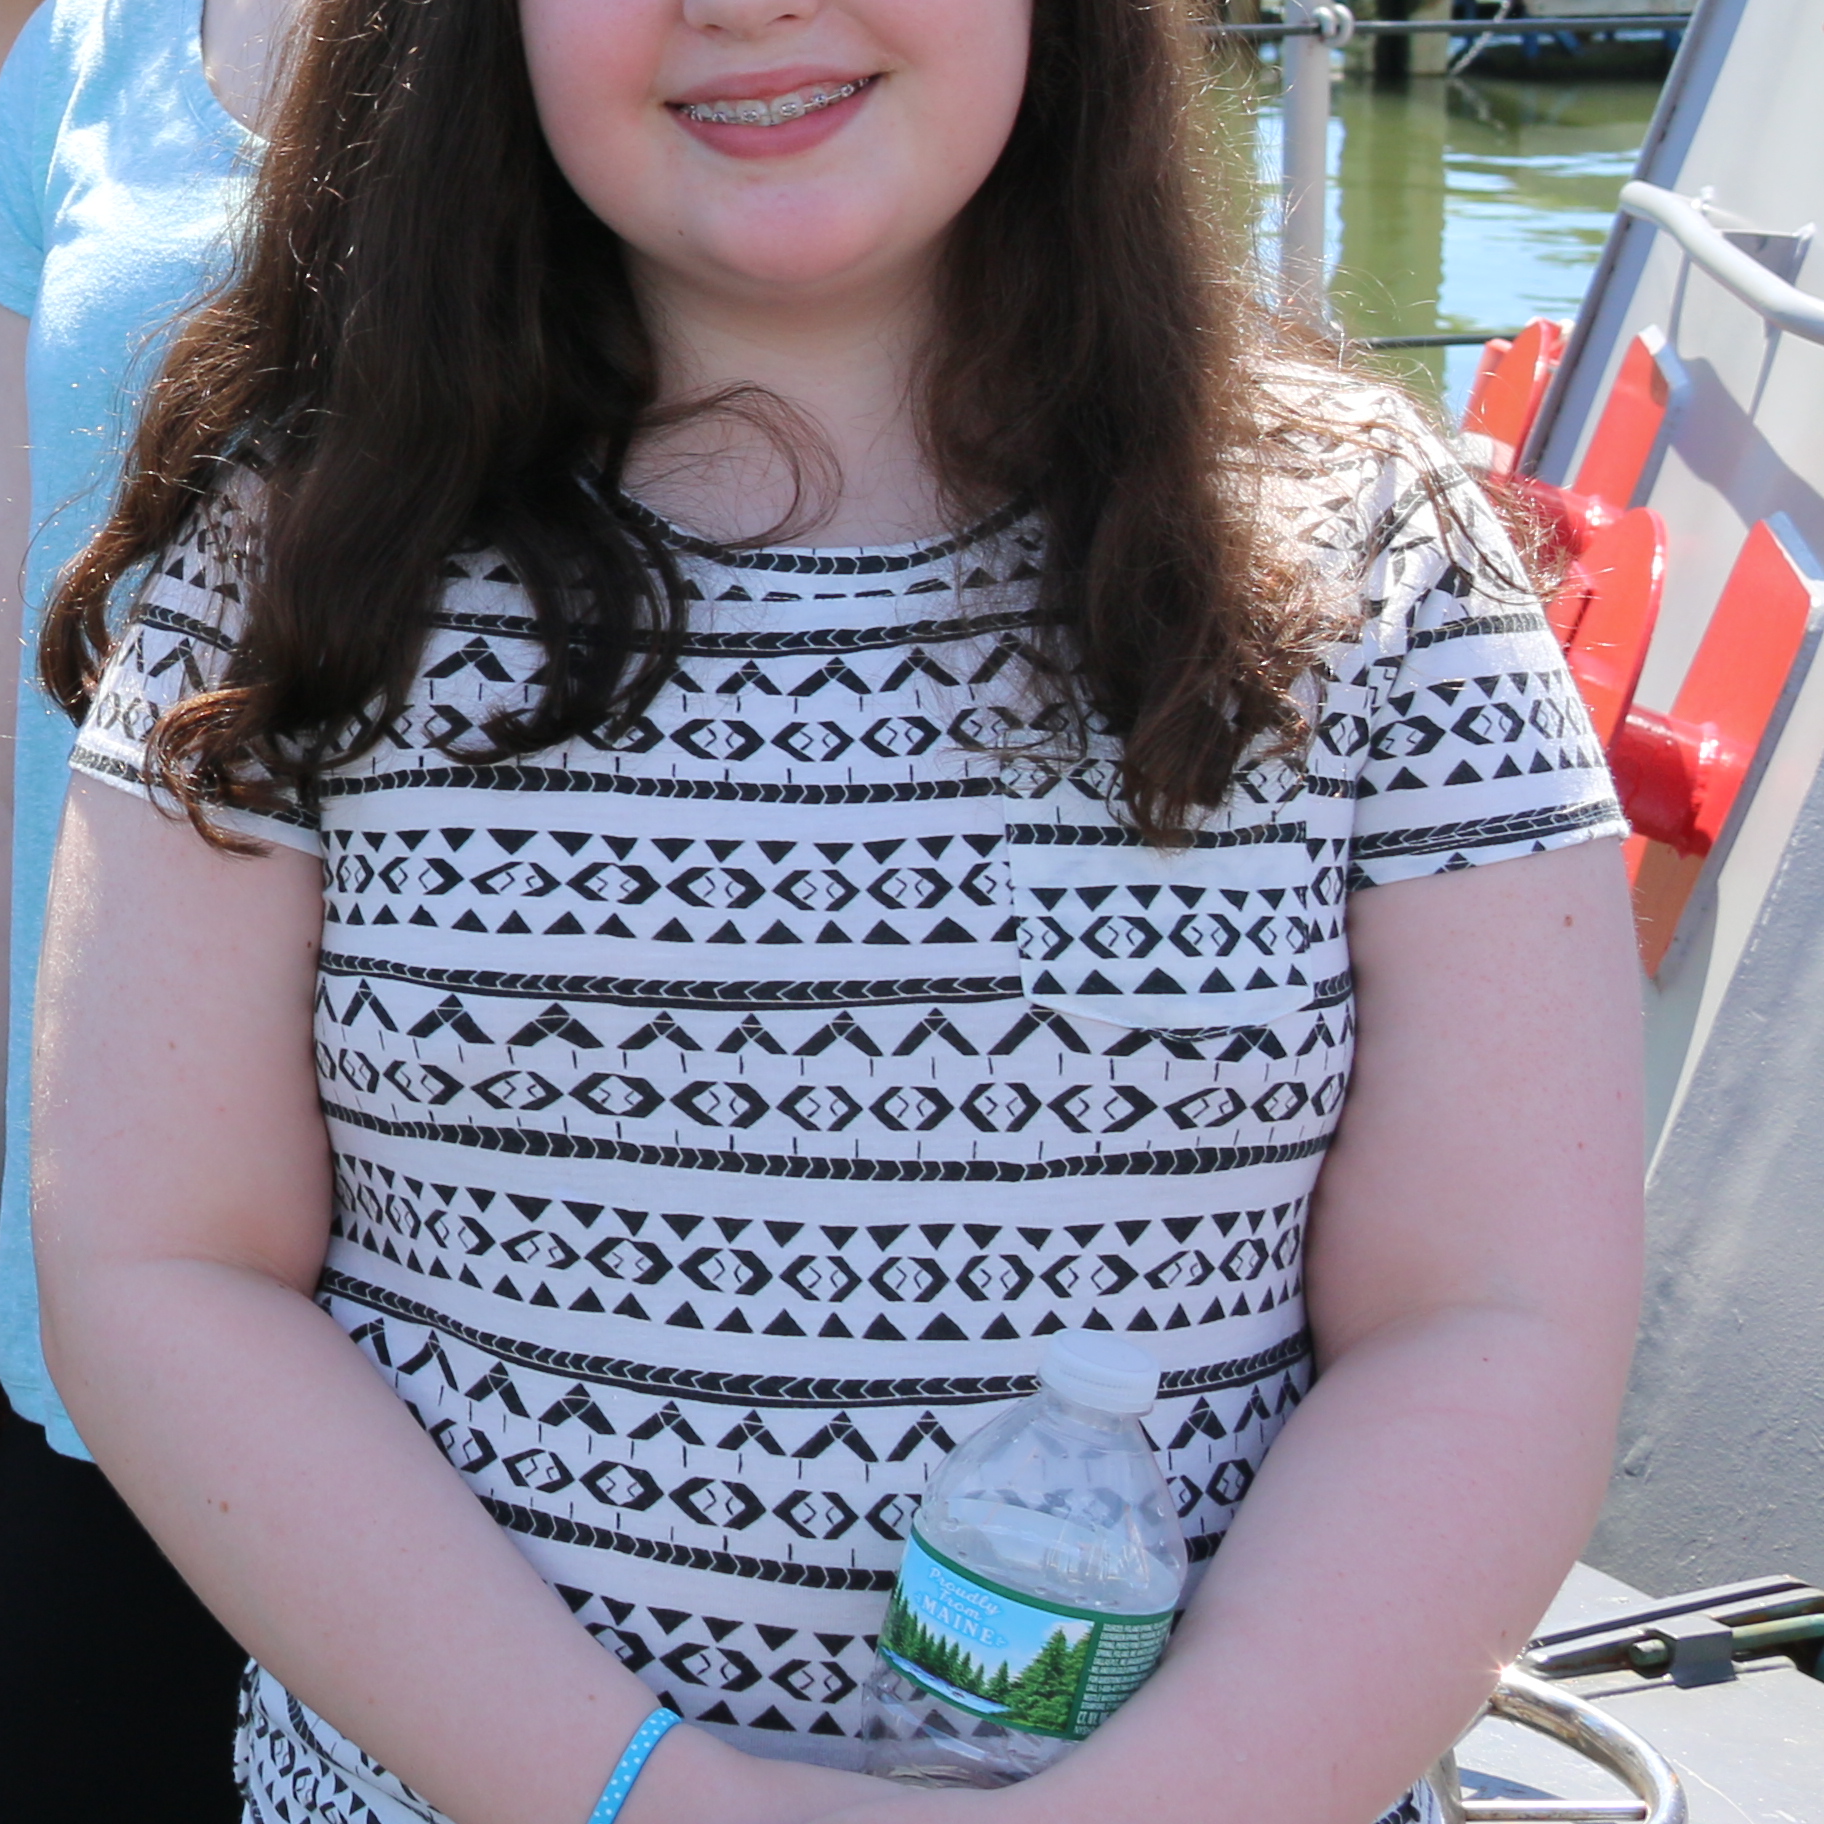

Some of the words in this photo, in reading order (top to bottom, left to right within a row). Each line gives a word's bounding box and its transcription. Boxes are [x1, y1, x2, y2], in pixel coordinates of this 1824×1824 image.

[929, 1566, 1001, 1616] Proudly
[940, 1587, 982, 1621] From
[922, 1594, 994, 1645] MAINE
